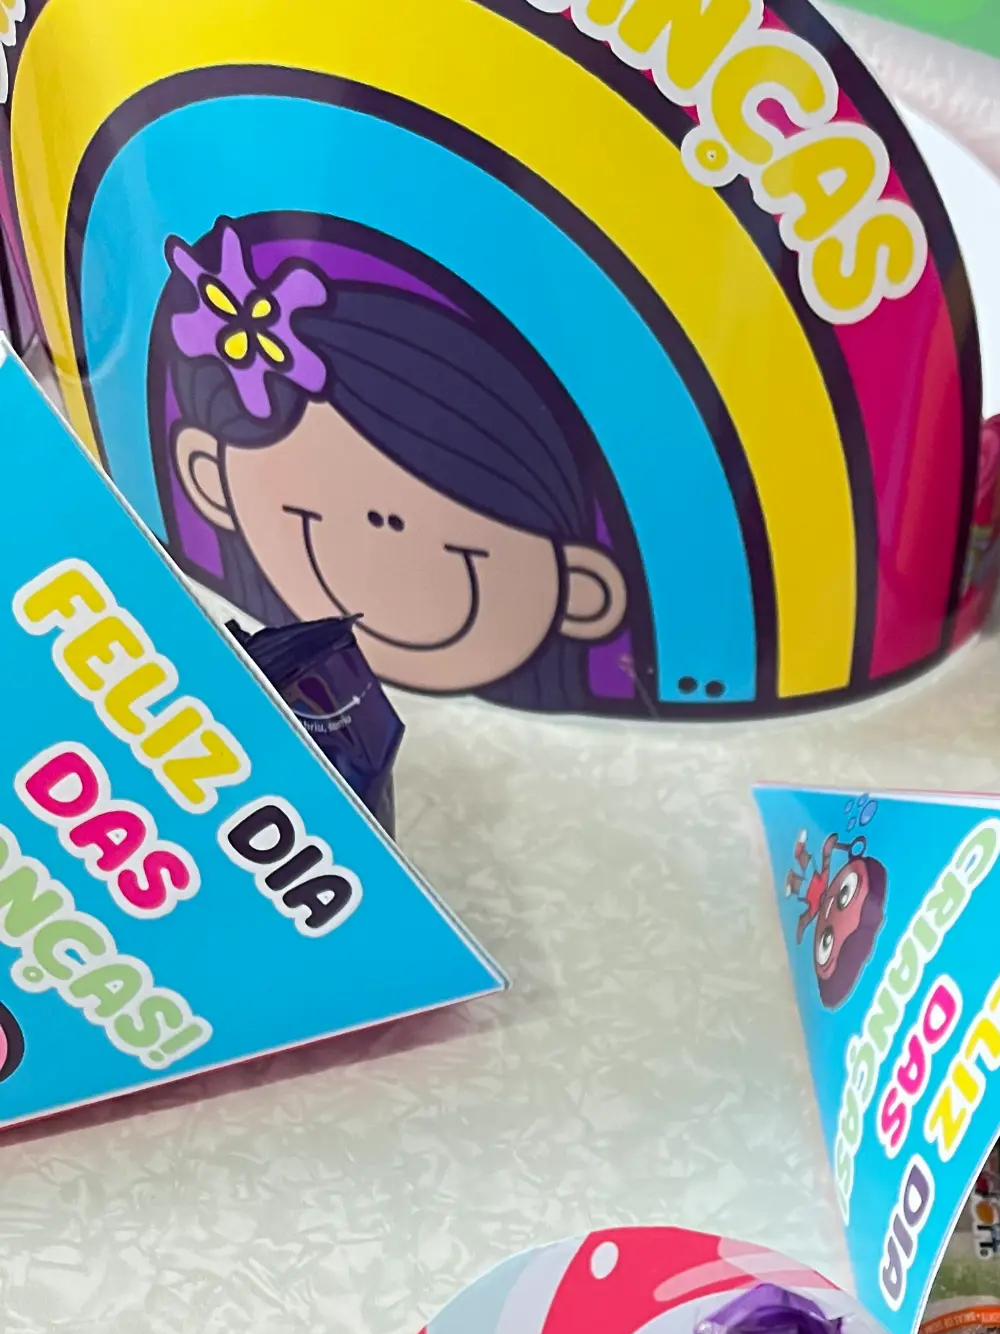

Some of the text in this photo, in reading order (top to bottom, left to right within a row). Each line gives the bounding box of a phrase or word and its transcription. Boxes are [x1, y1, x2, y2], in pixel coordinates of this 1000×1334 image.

[570, 0, 928, 325] NÇAS
[13, 557, 363, 938] FELIZ DIA
[14, 741, 201, 920] DAS
[0, 822, 212, 1070] NÇAS!
[876, 975, 963, 1160] DAS
[879, 1153, 935, 1311] DIA
